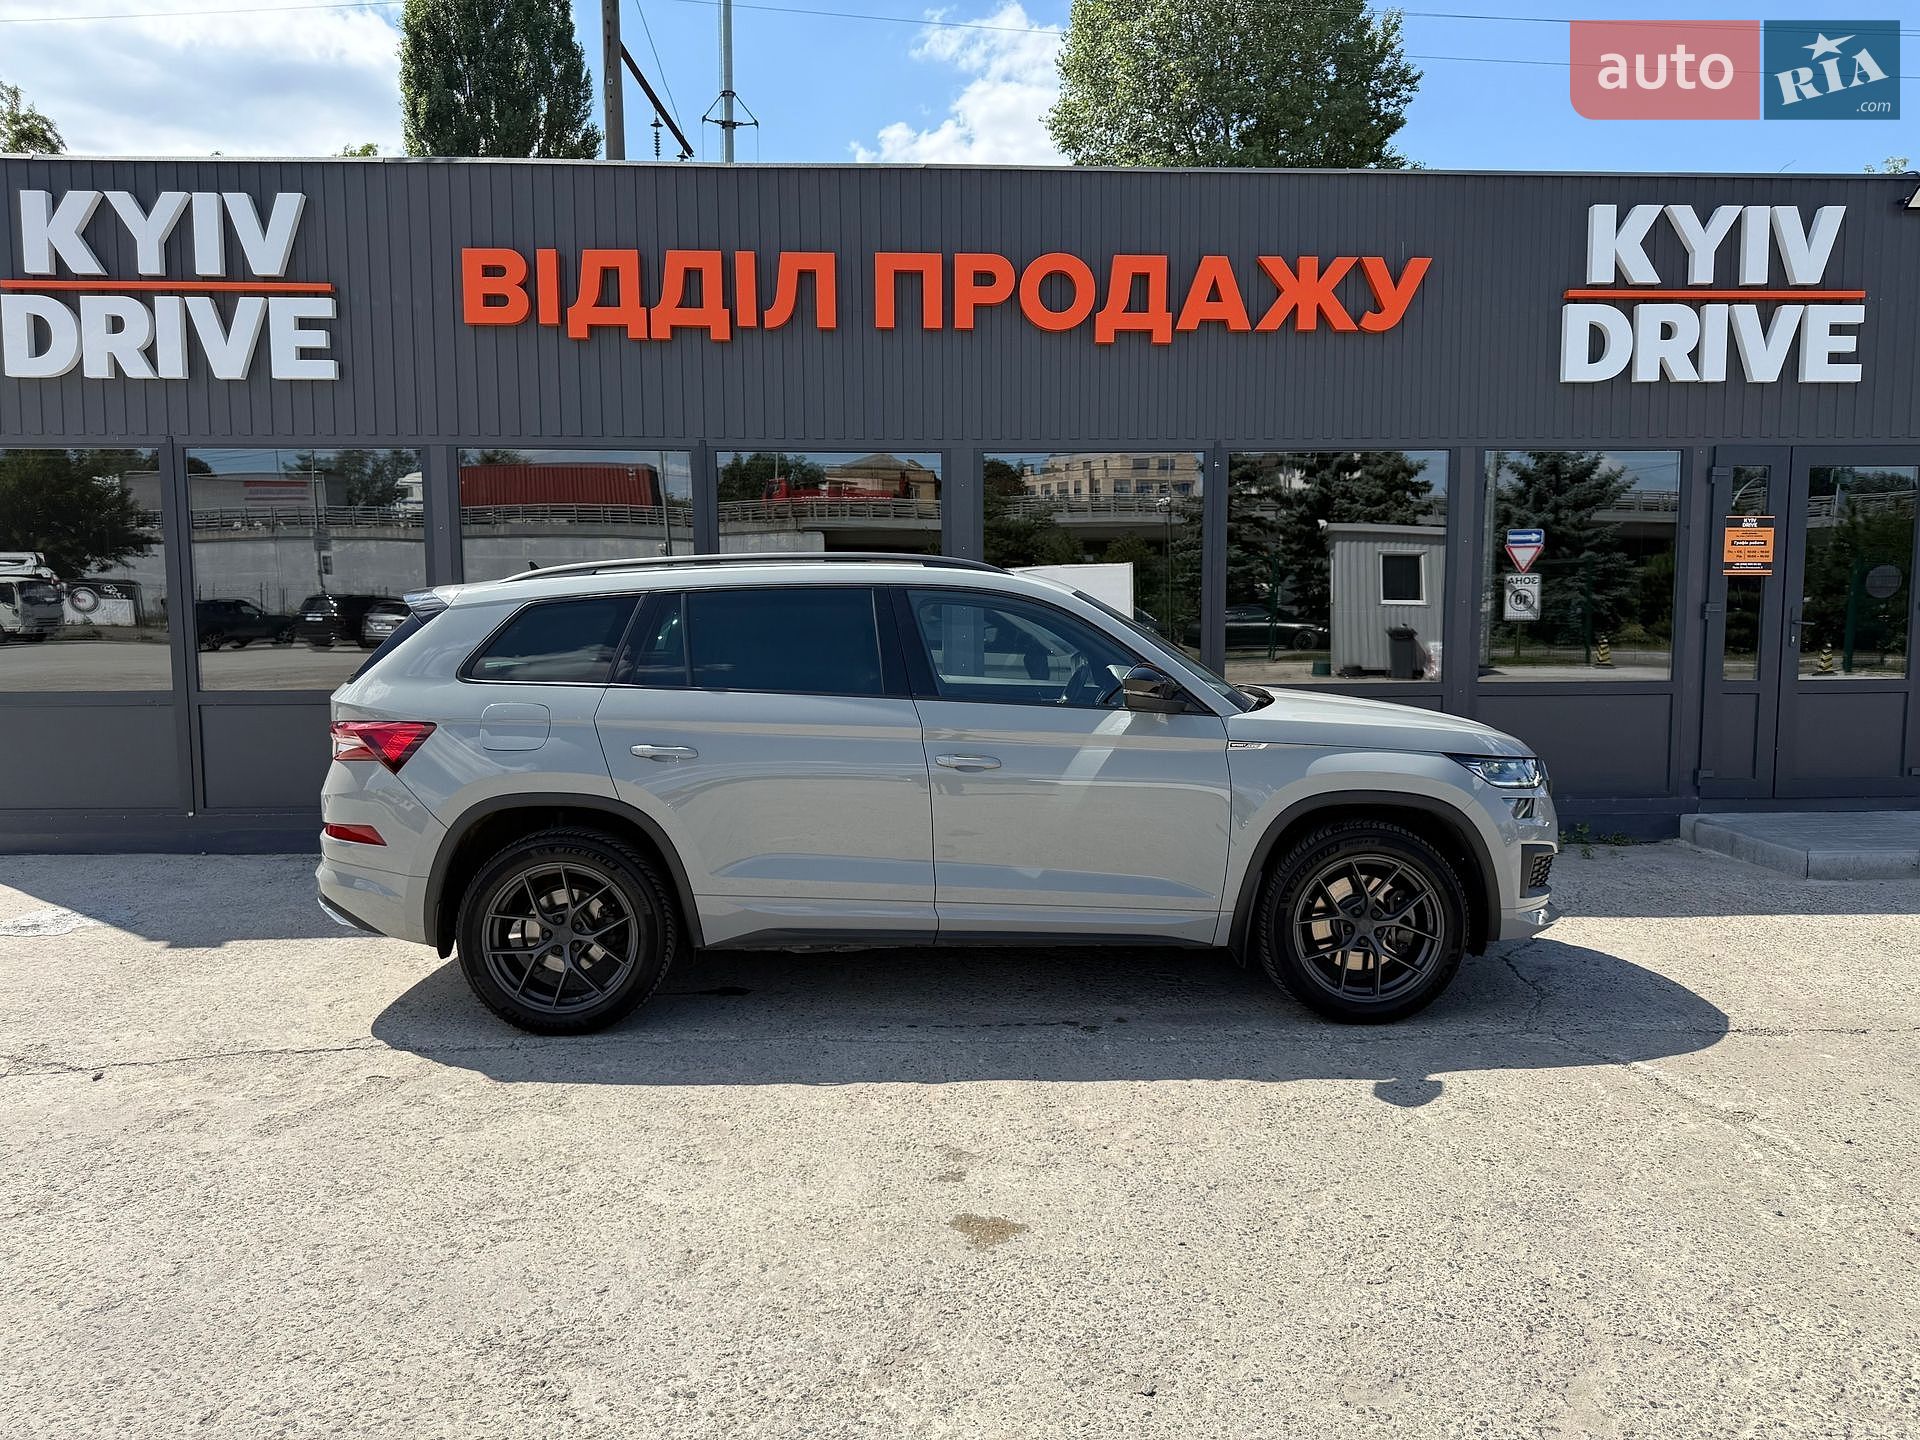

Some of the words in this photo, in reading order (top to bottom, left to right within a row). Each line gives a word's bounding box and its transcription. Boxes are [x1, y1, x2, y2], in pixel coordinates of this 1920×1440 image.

[19, 189, 307, 277] KYIV
[1586, 204, 1847, 286] KYIV
[0, 294, 340, 381] DRIVE
[461, 247, 837, 341] ВІДДІЛ
[874, 251, 1432, 344] ПРОДАЖУ
[1559, 303, 1866, 384] DRIVE
